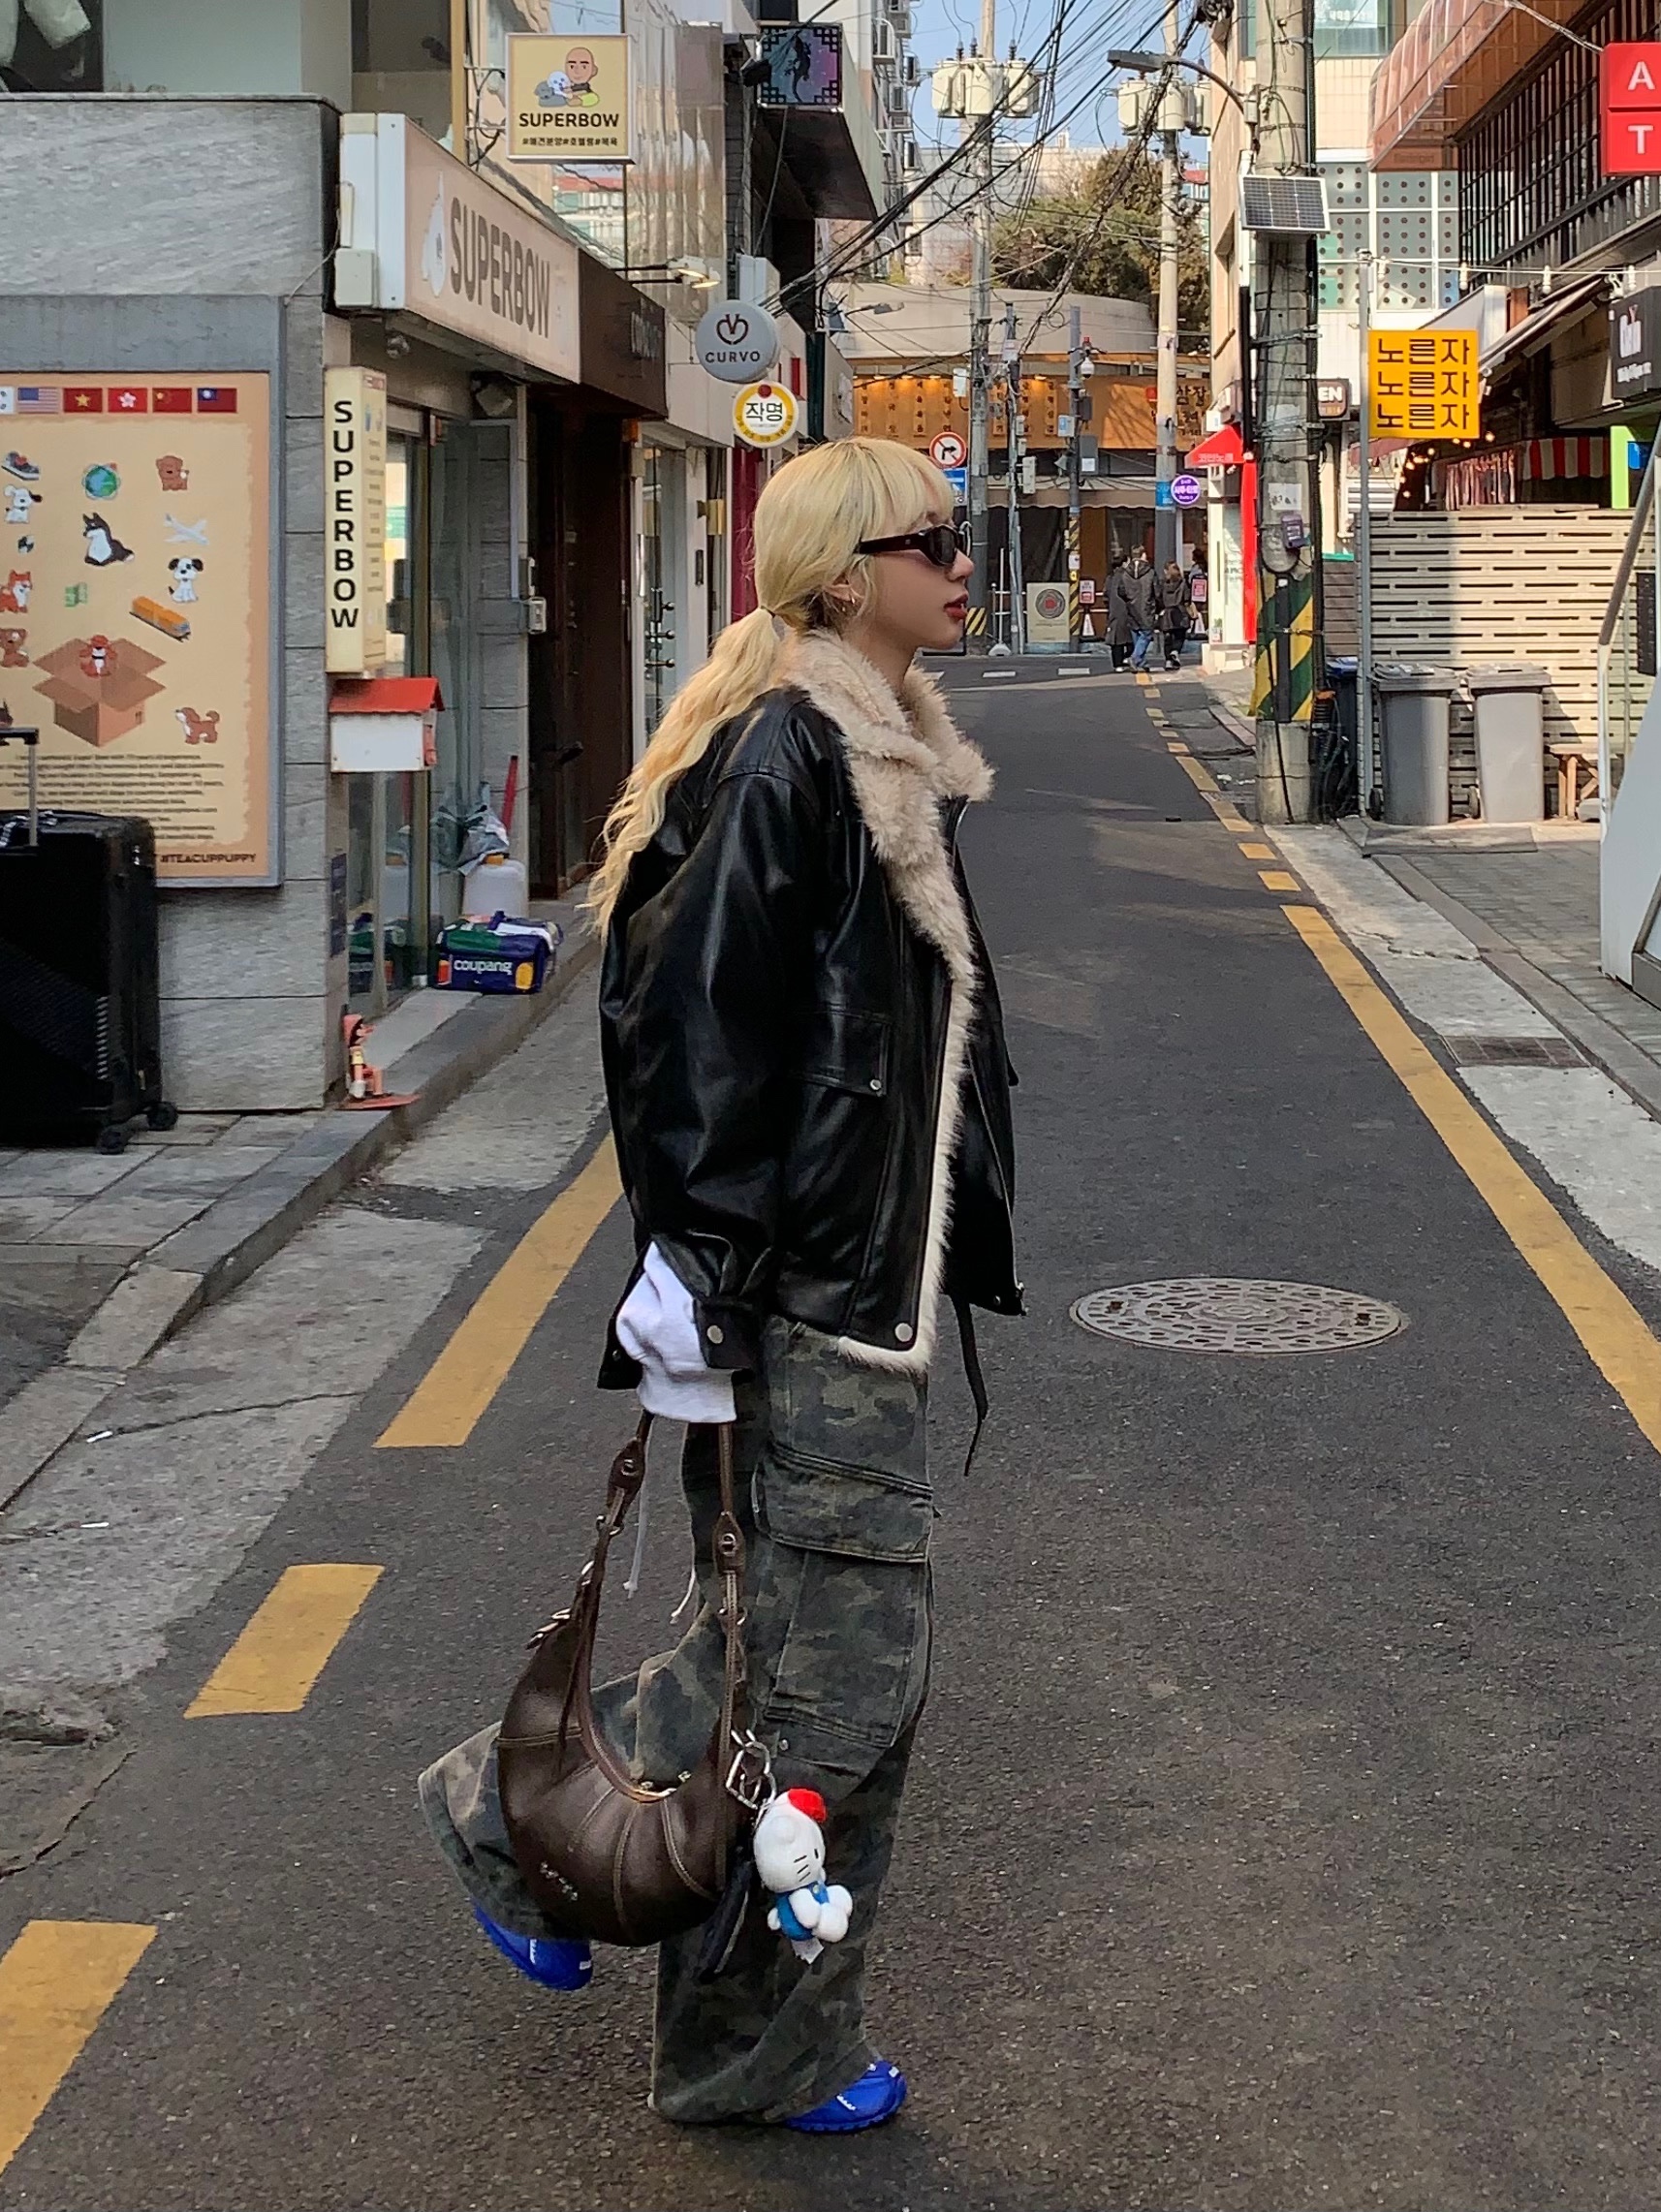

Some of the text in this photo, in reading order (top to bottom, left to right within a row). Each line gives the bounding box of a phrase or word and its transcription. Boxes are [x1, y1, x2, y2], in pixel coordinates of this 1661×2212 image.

[518, 112, 619, 127] SUPERBOW
[450, 197, 550, 339] SUPERBOW
[705, 350, 761, 363] CURVO
[1377, 338, 1470, 365] 노른자
[1377, 371, 1470, 398] 노른자
[745, 402, 783, 422] 작명
[1377, 403, 1470, 430] 노른자
[330, 401, 359, 629] SUPERBOW
[453, 959, 513, 976] coupang
